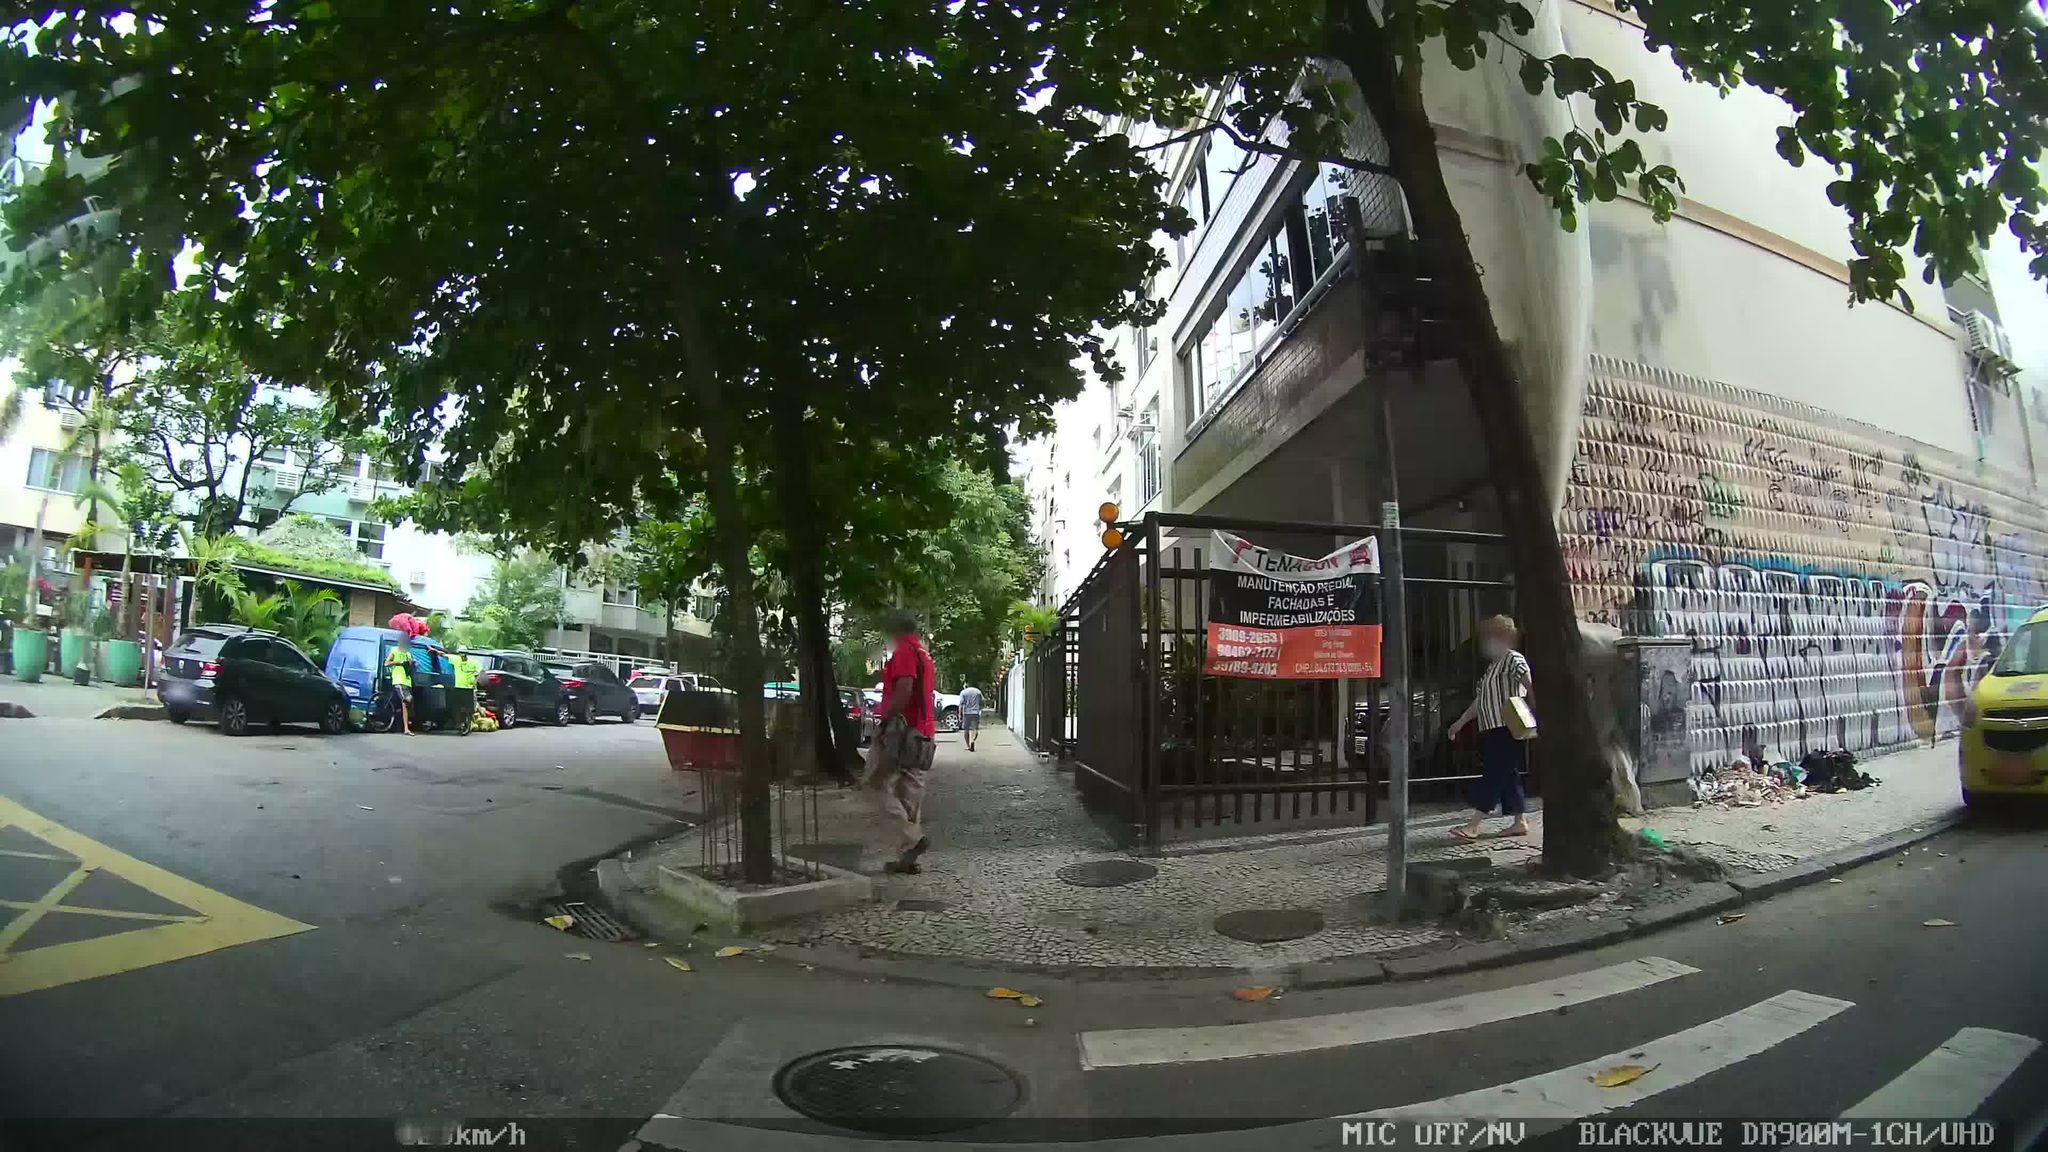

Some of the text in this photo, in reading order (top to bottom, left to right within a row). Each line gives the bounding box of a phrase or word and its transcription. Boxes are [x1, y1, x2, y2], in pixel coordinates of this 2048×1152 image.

[1238, 575, 1315, 596] MANUTENÇÃO
[1268, 594, 1335, 610] FACHADAS E
[1240, 607, 1356, 626] IMPERMEABILIZAÇÕES
